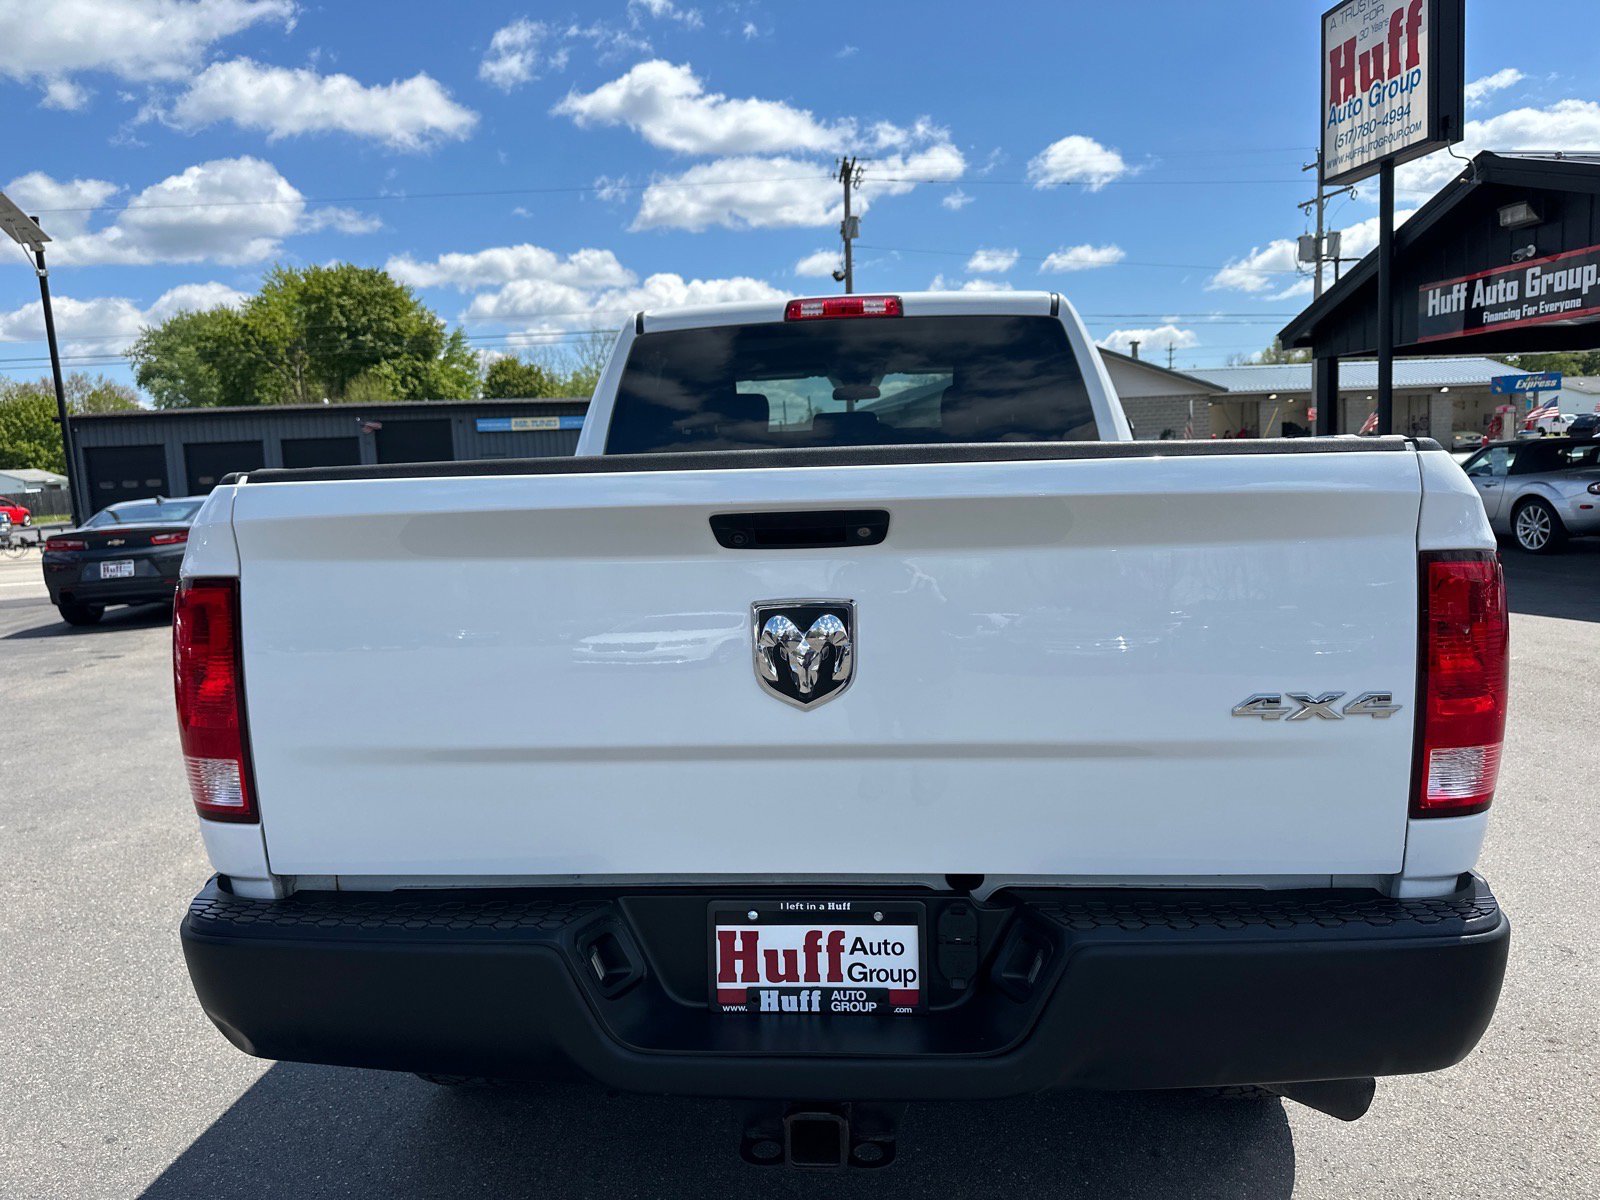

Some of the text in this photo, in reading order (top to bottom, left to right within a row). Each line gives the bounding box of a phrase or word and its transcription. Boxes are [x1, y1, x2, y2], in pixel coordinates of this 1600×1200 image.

[1329, 0, 1382, 32] A TRUST
[1362, 4, 1385, 24] FOR
[1358, 17, 1390, 42] 30 Years
[1329, 0, 1423, 108] Huff
[1327, 68, 1422, 130] Auto Group
[1334, 102, 1412, 152] (517)780-4994
[1427, 282, 1468, 318] Huff
[1471, 278, 1519, 309] Auto
[1482, 298, 1582, 324] Financing For Everyone
[1515, 379, 1557, 391] Express
[1231, 690, 1403, 721] 4X4
[786, 902, 804, 911] left
[806, 902, 816, 911] in
[827, 902, 851, 911] Huff
[717, 930, 846, 983] Huff
[848, 936, 905, 956] Auto
[847, 962, 917, 988] Group
[759, 990, 822, 1012] Huff
[831, 990, 867, 1001] AUTO
[893, 1006, 913, 1014] .com
[831, 1001, 878, 1012] GROUP
